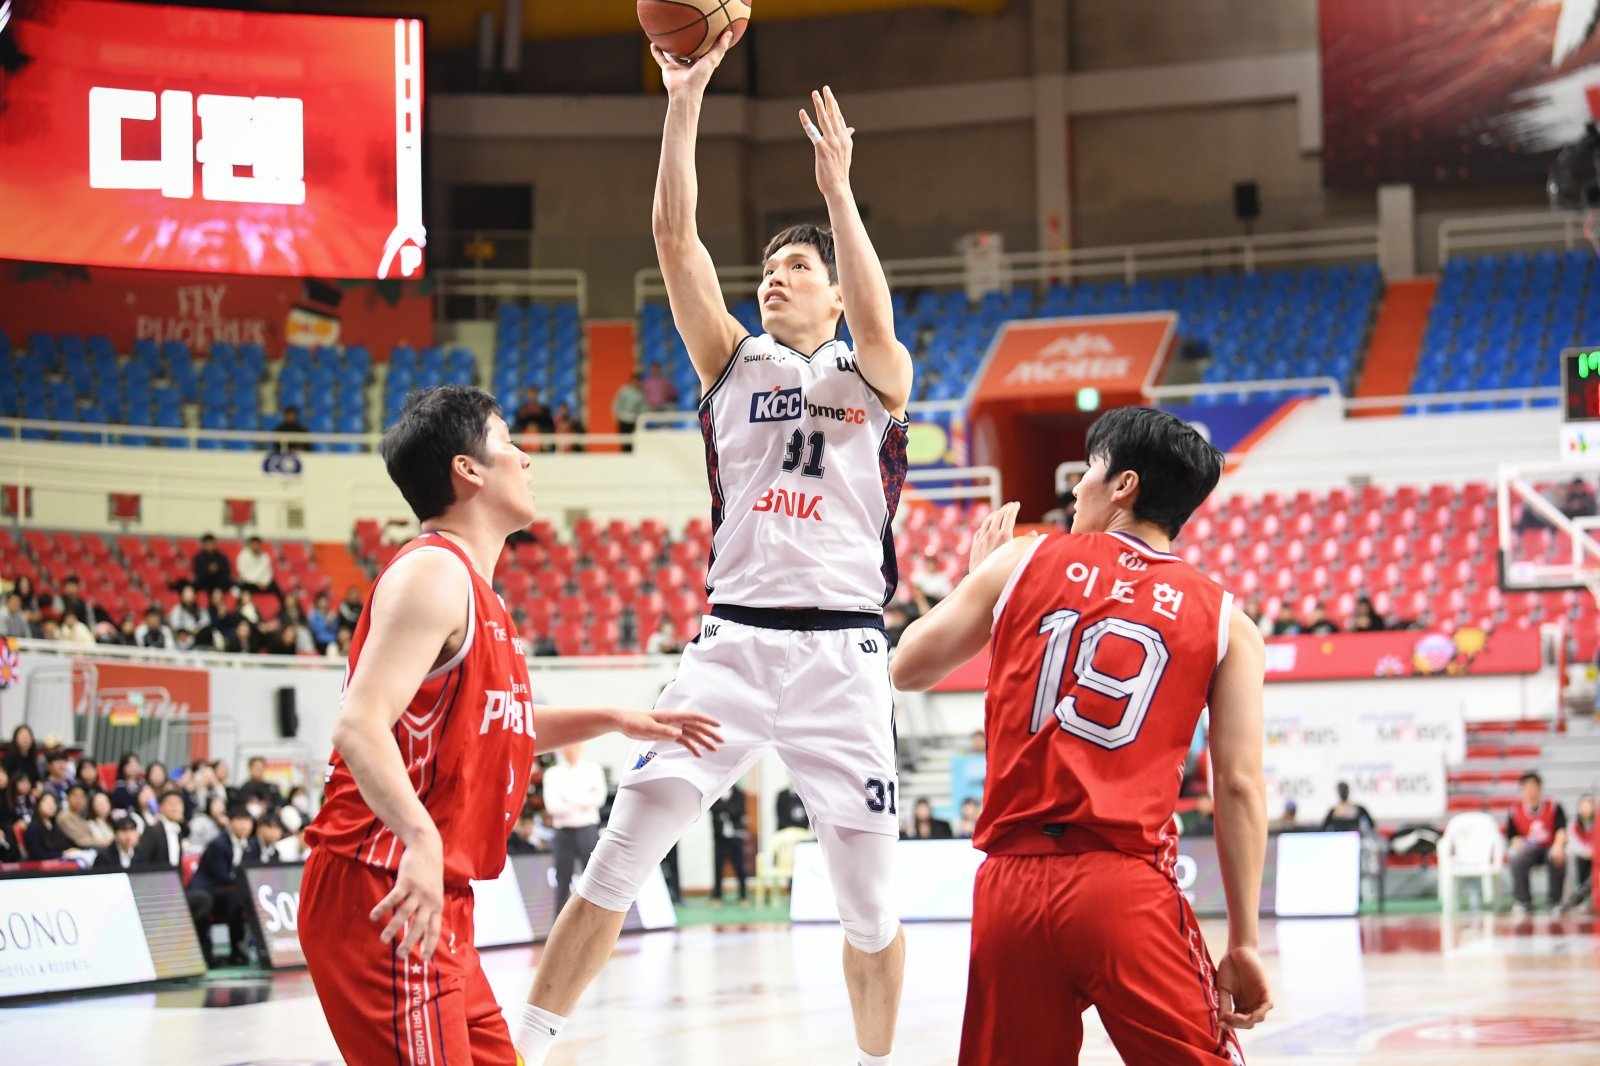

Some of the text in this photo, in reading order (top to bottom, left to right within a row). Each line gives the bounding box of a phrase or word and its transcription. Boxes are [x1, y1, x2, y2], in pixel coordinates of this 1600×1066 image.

[754, 388, 801, 419] KCC
[781, 426, 826, 480] 31
[752, 487, 823, 522] BNK
[1029, 607, 1172, 752] 19
[865, 777, 897, 816] 31
